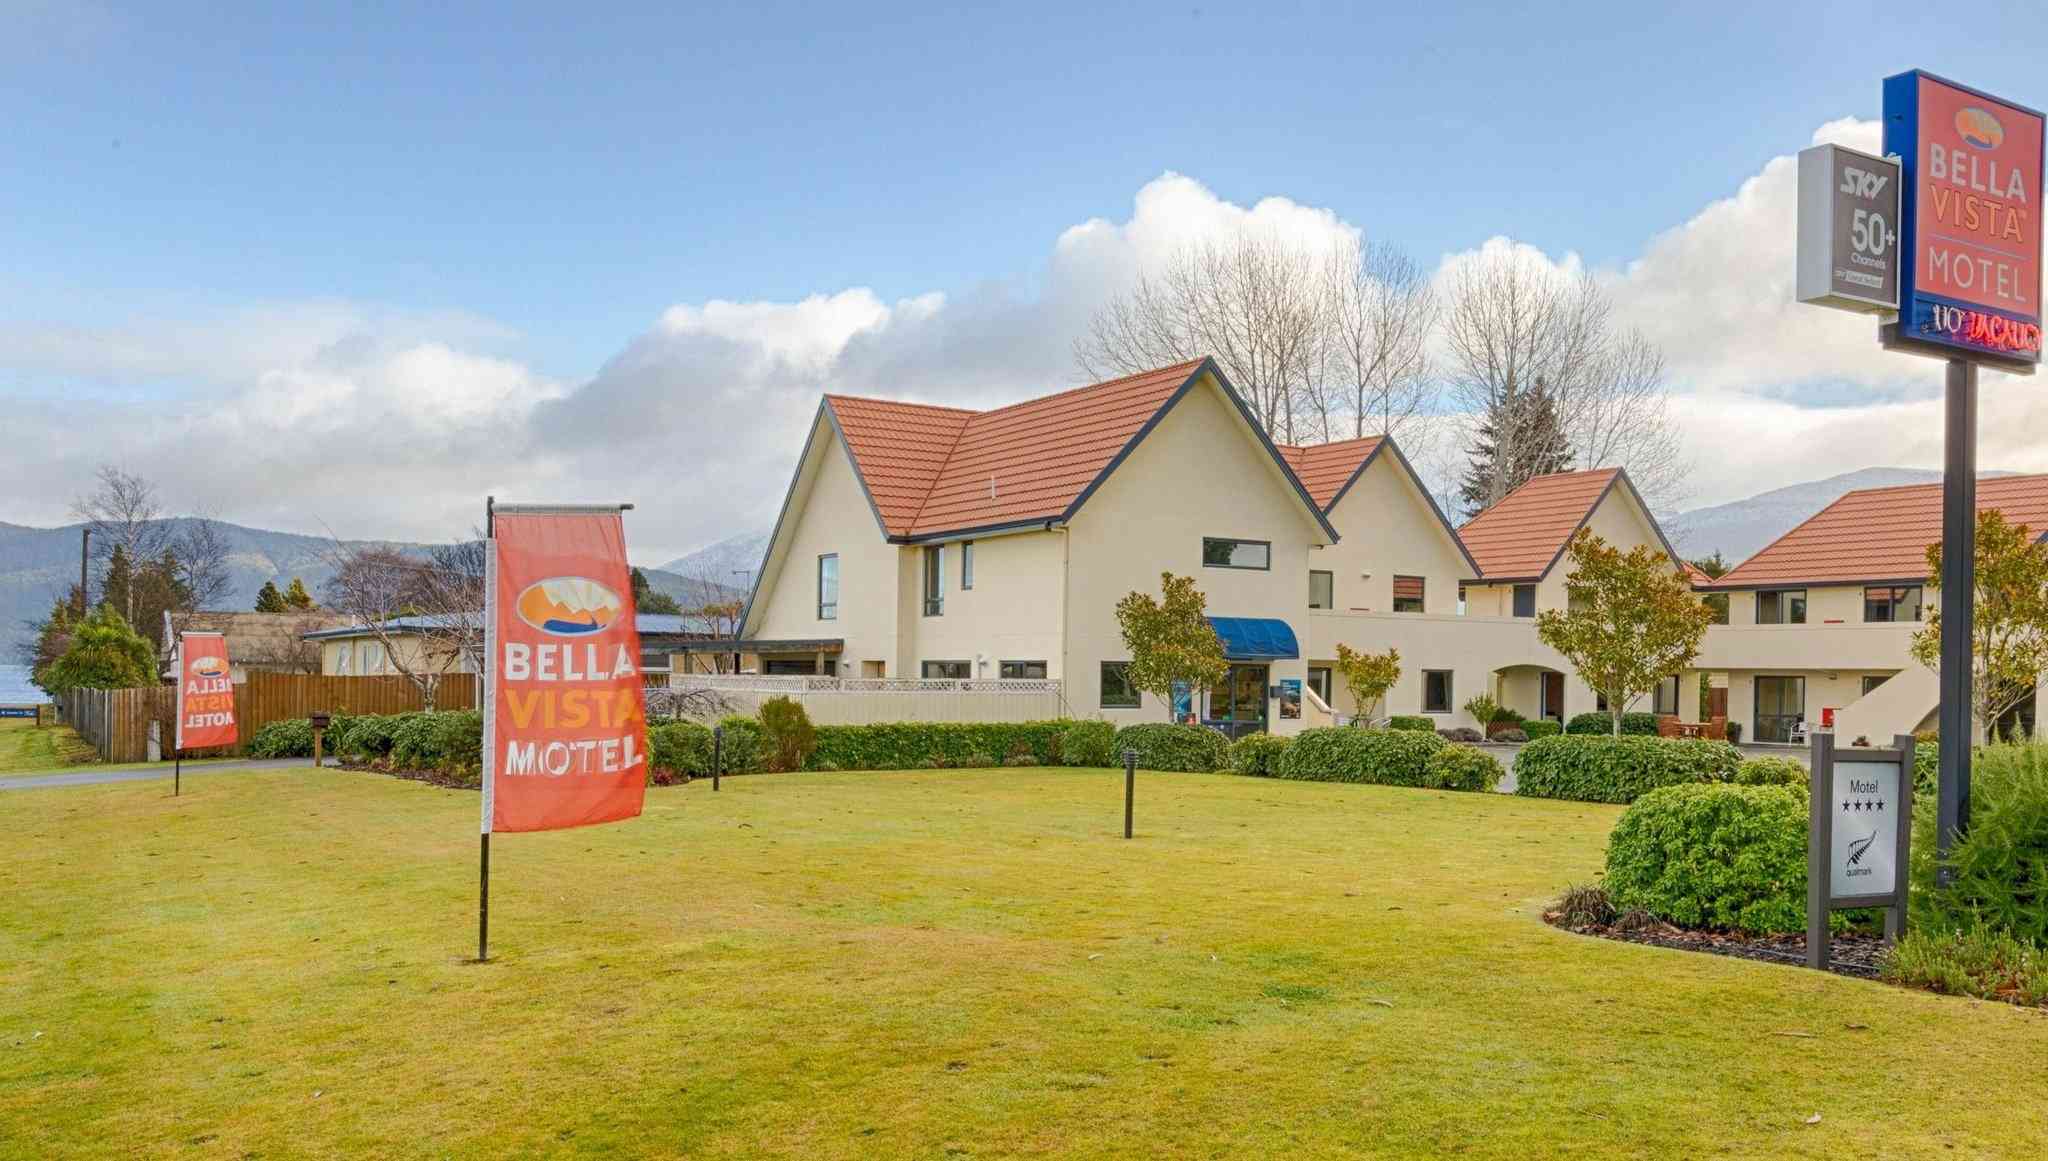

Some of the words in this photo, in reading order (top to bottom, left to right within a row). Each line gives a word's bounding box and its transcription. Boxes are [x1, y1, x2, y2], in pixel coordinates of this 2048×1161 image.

[1840, 167, 1889, 200] SKY
[1929, 143, 2027, 204] BELLA
[1851, 208, 1896, 255] 50+
[1929, 183, 2024, 243] VISTA
[1928, 246, 2027, 302] MOTEL
[1967, 310, 2041, 353] VACANC
[504, 642, 638, 681] BELLA
[504, 688, 642, 729] VISTA
[505, 735, 643, 777] MOTEL
[1850, 779, 1879, 794] Motel
